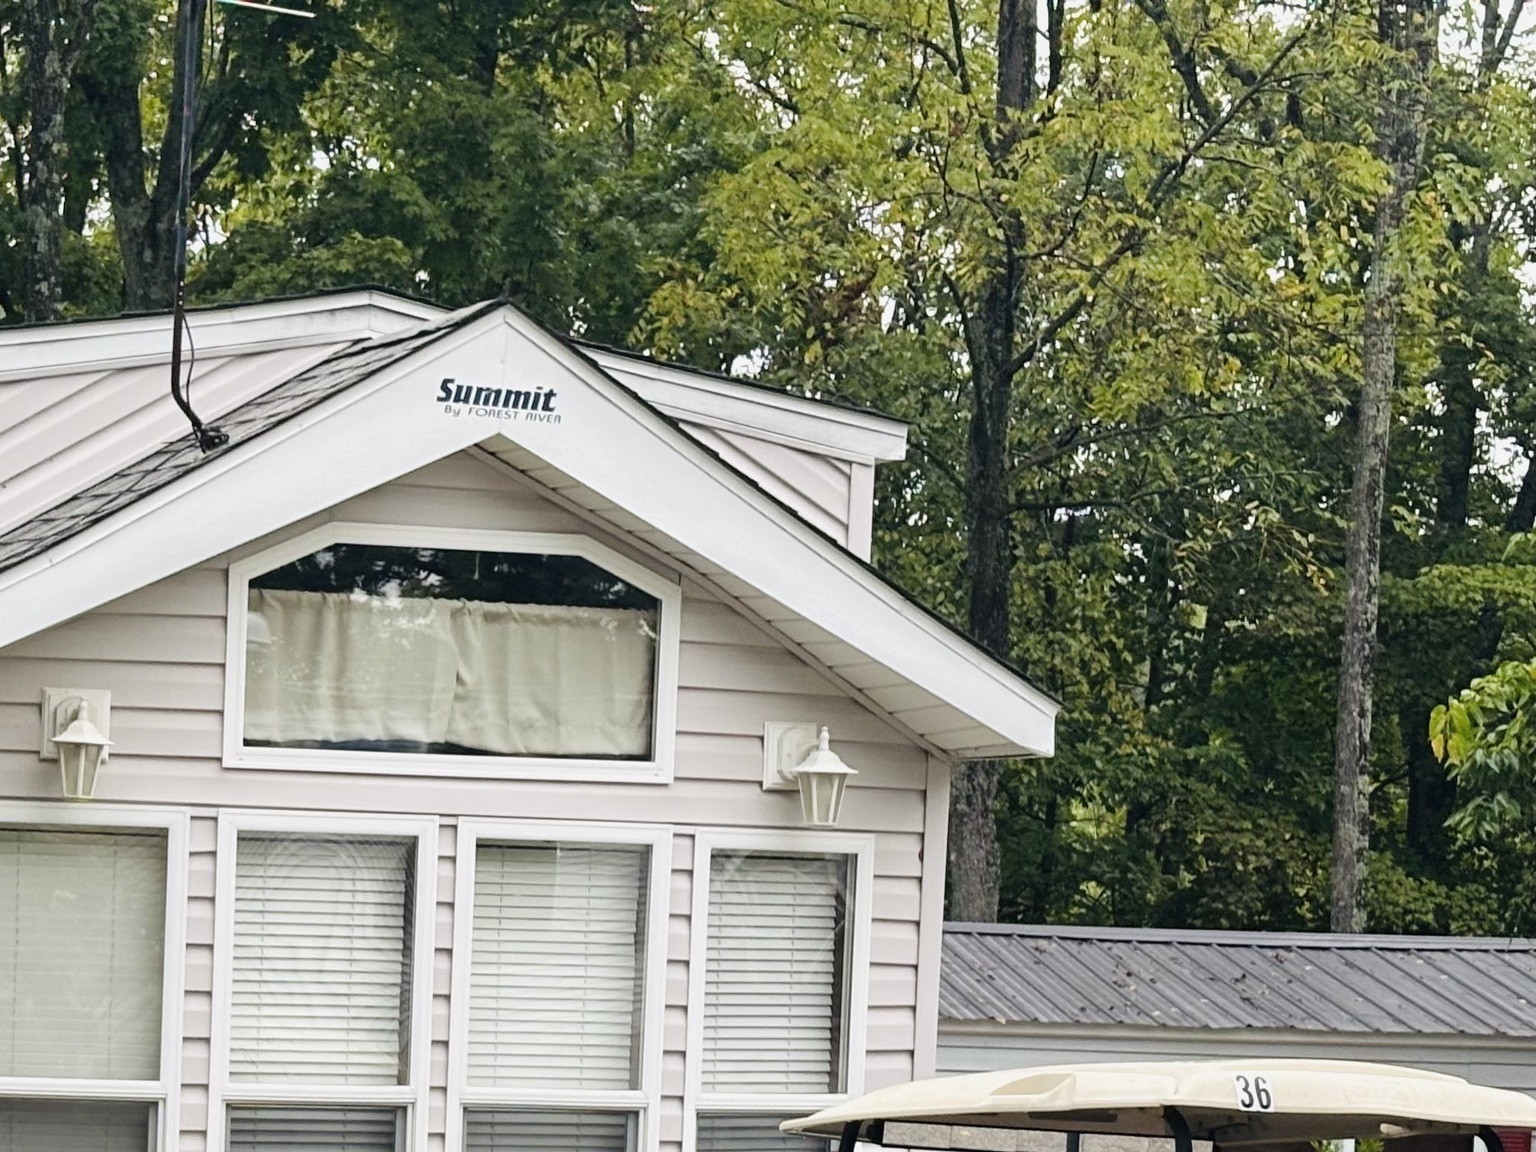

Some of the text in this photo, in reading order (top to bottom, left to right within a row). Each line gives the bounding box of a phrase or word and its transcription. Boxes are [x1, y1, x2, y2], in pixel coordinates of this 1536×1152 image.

[436, 378, 557, 412] Summit
[444, 404, 562, 424] By FOREST RIVER
[1236, 1075, 1271, 1109] 36
